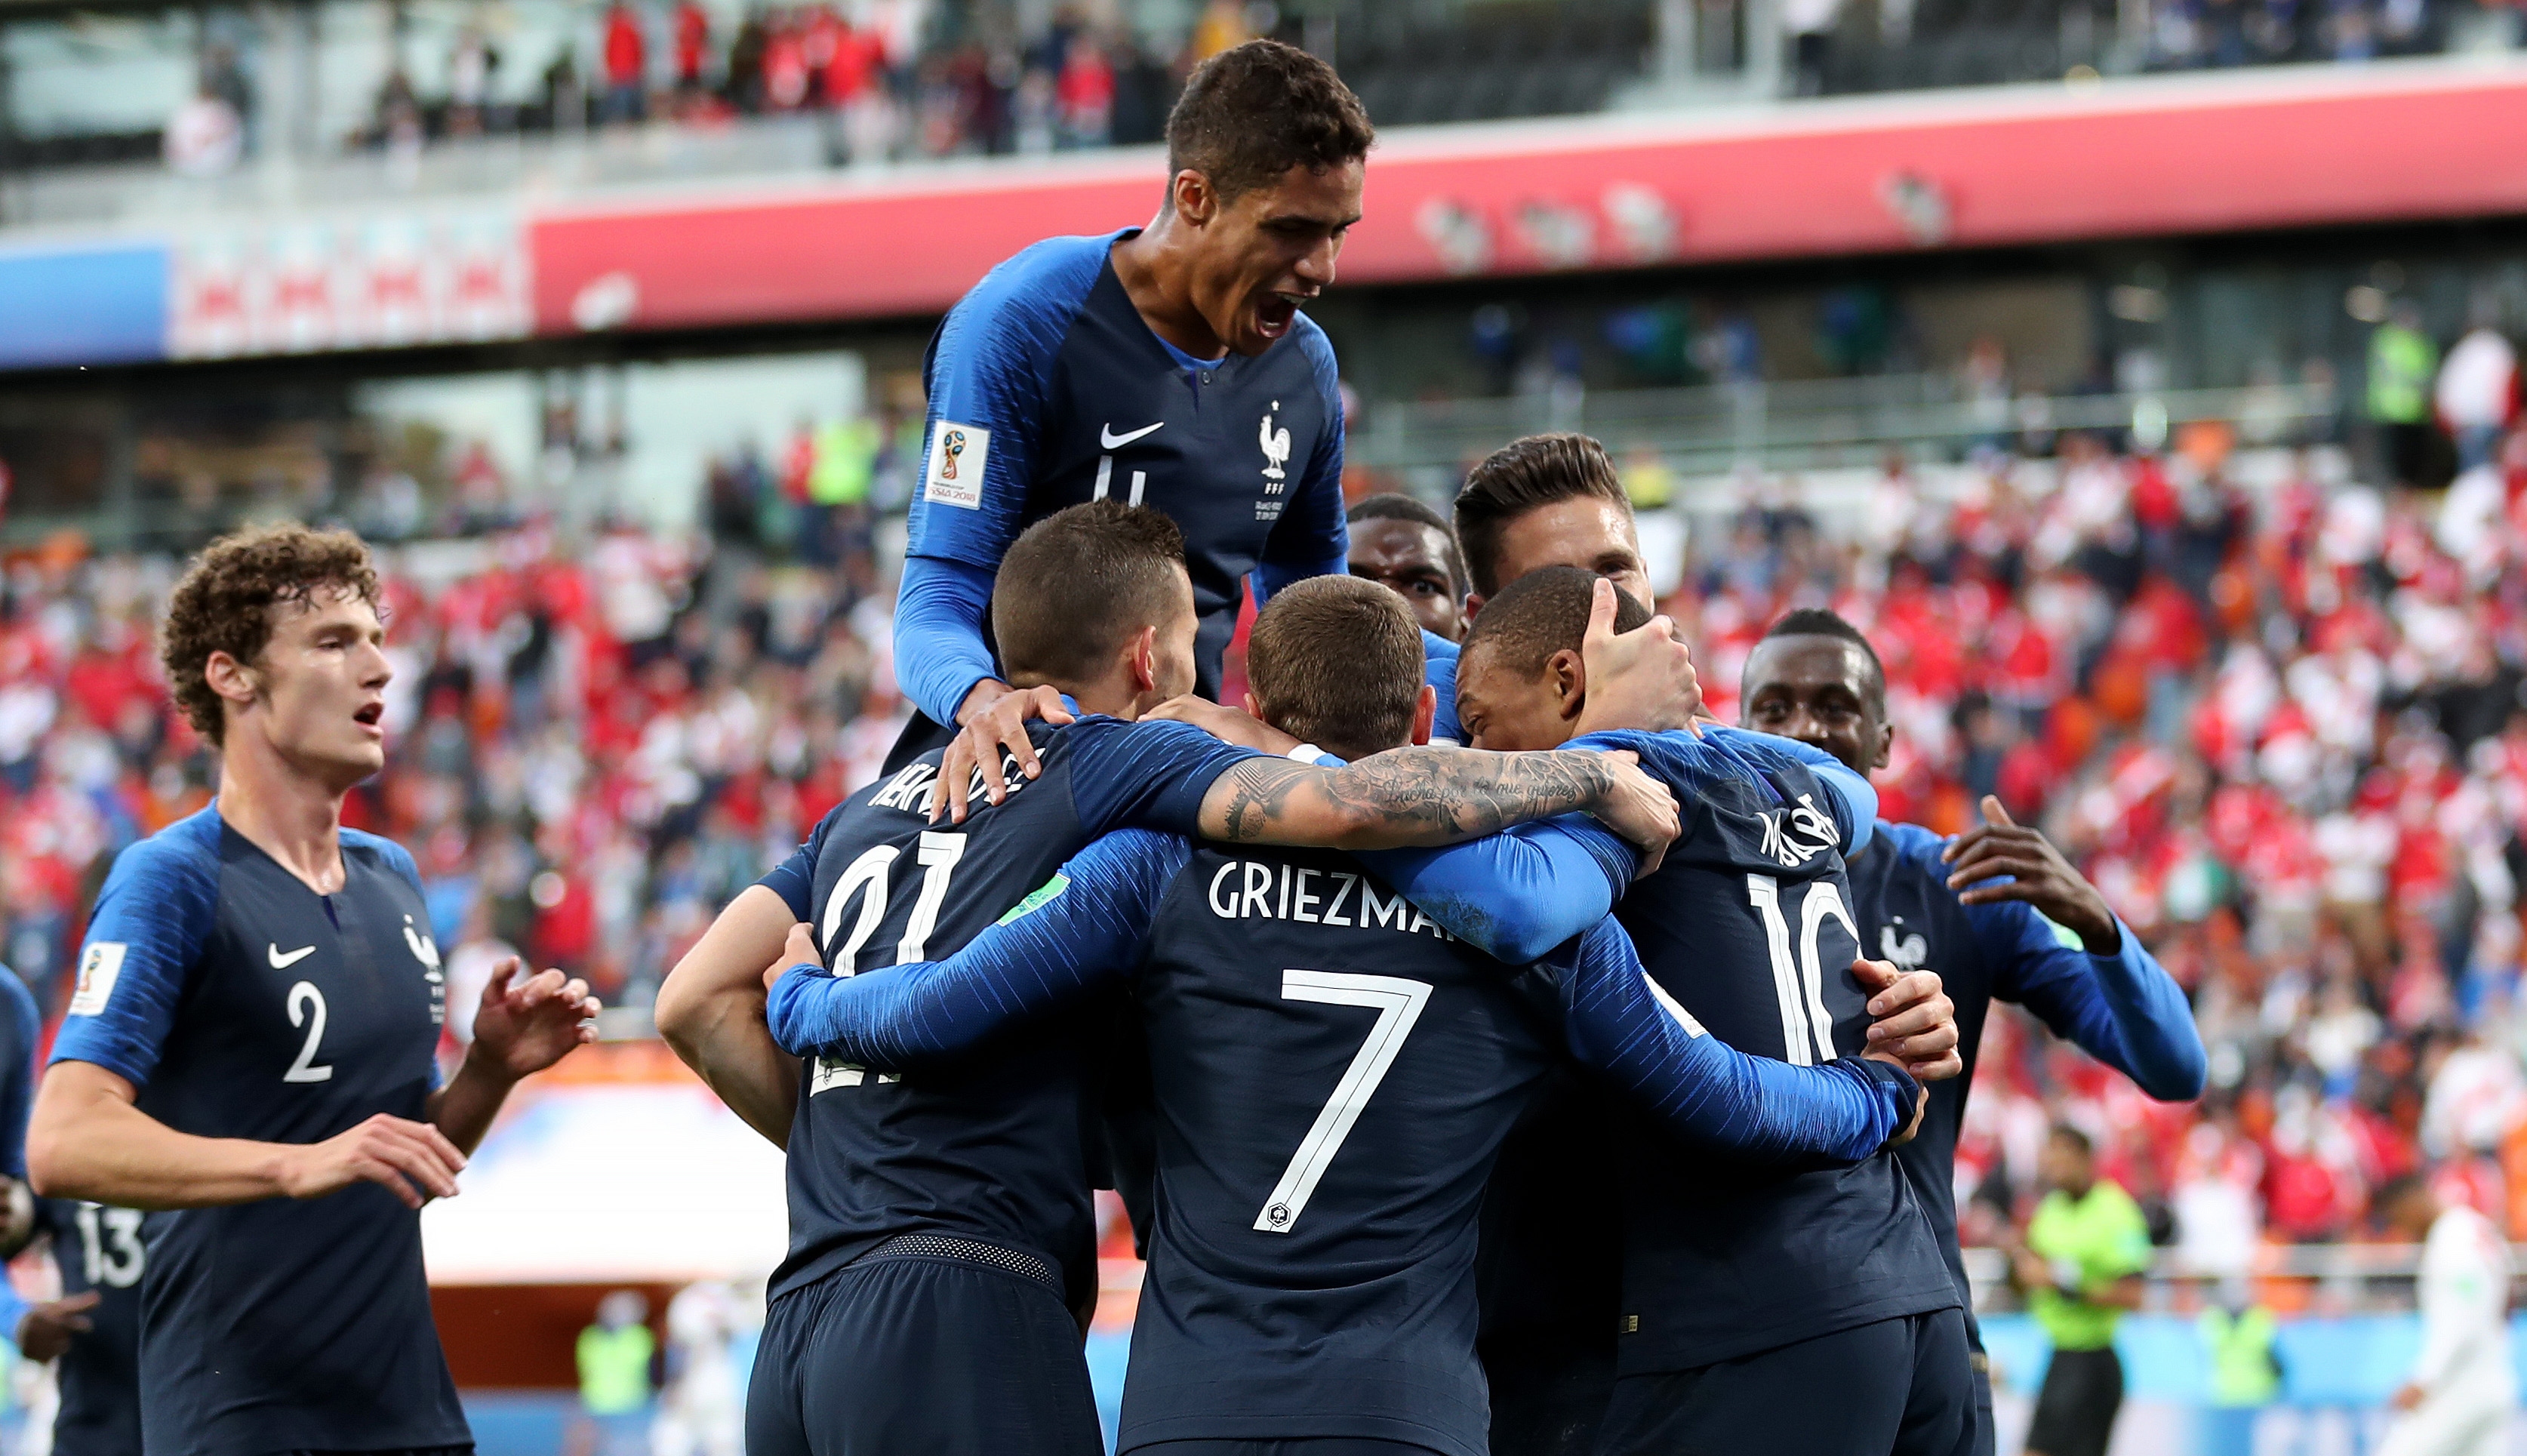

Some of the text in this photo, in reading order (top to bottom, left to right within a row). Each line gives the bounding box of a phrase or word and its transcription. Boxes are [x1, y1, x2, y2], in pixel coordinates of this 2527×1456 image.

[809, 830, 967, 1097] 21
[1209, 862, 1454, 941] GRIEZMA
[1747, 873, 1864, 1067] 10
[283, 980, 332, 1082] 2
[1253, 969, 1434, 1233] 7
[75, 1208, 147, 1288] 13
